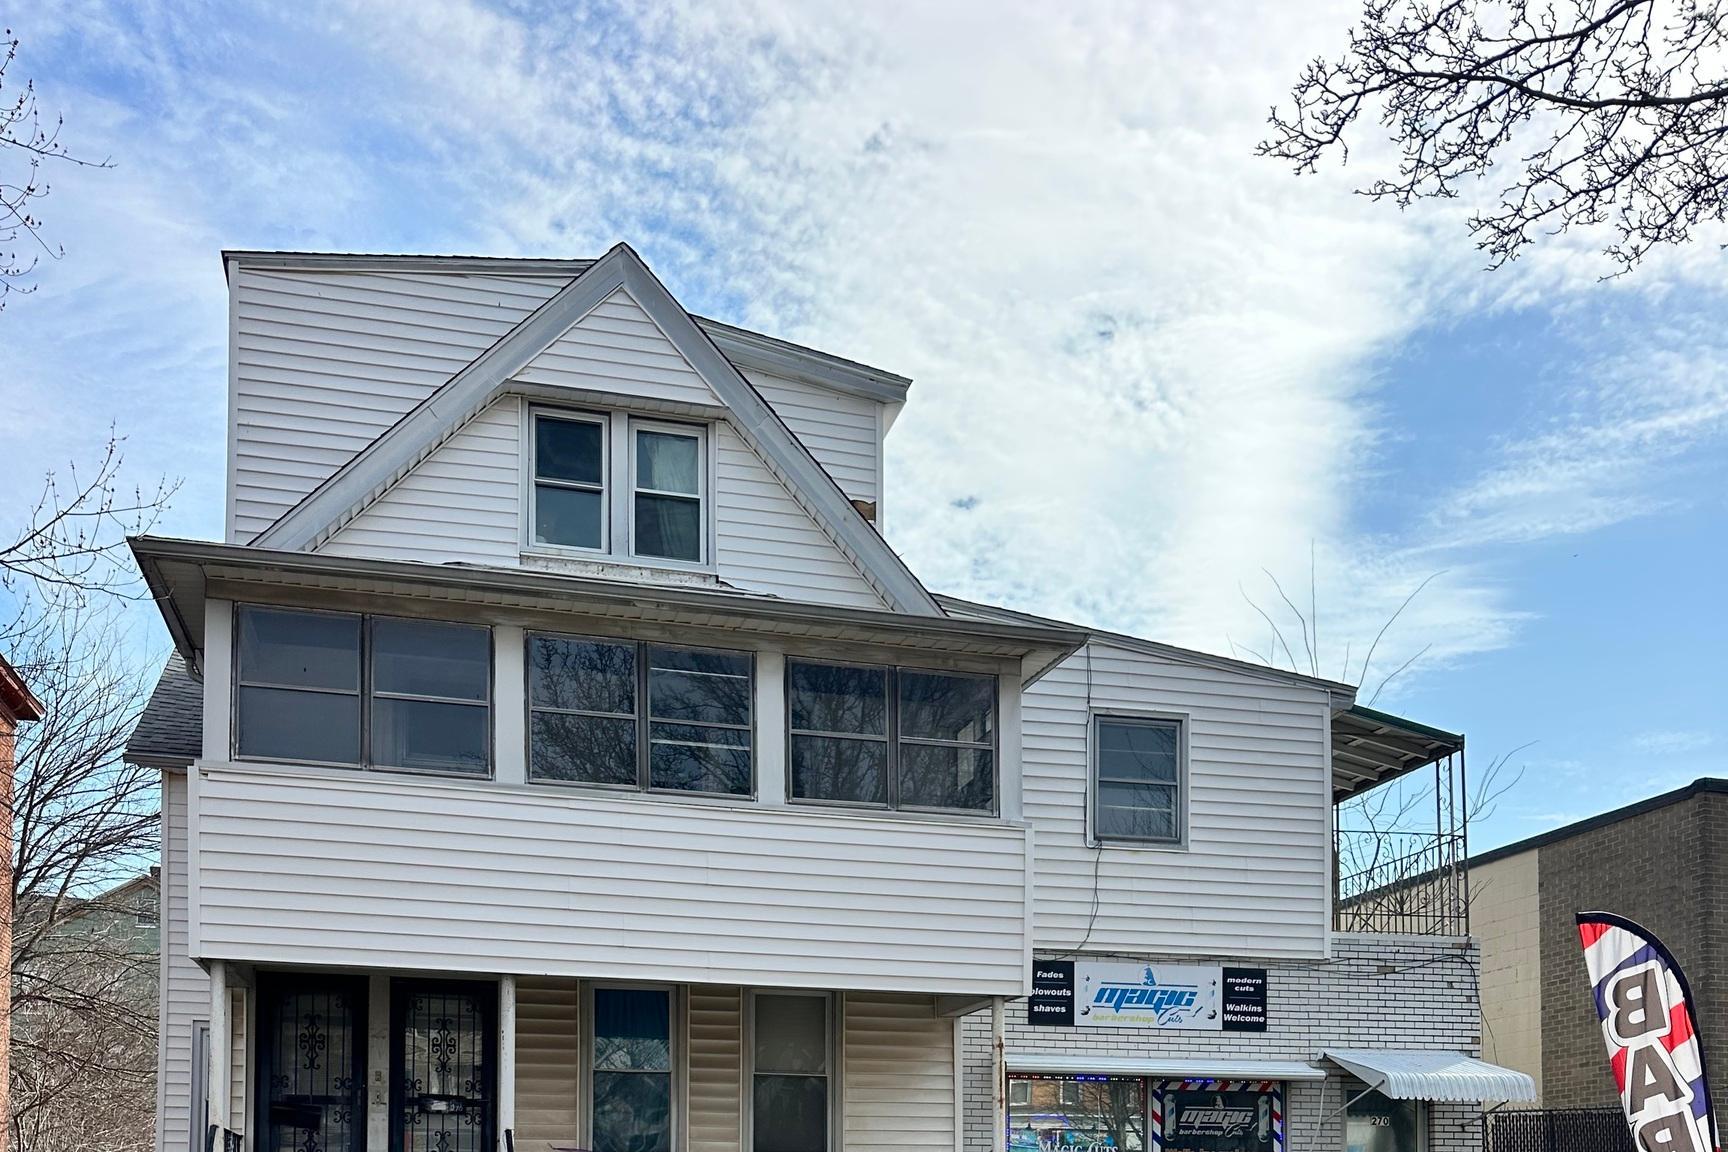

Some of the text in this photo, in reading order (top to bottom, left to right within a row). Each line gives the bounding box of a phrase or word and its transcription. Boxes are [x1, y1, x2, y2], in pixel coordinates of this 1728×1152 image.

[1036, 970, 1064, 979] Fades
[1226, 977, 1262, 985] modern
[1033, 1004, 1066, 1013] shaves
[1226, 1003, 1262, 1013] Walkins
[1092, 1014, 1154, 1024] barbershop
[1157, 1006, 1183, 1026] Cuts
[1223, 1013, 1265, 1023] Welcome
[1371, 1116, 1389, 1126] 270
